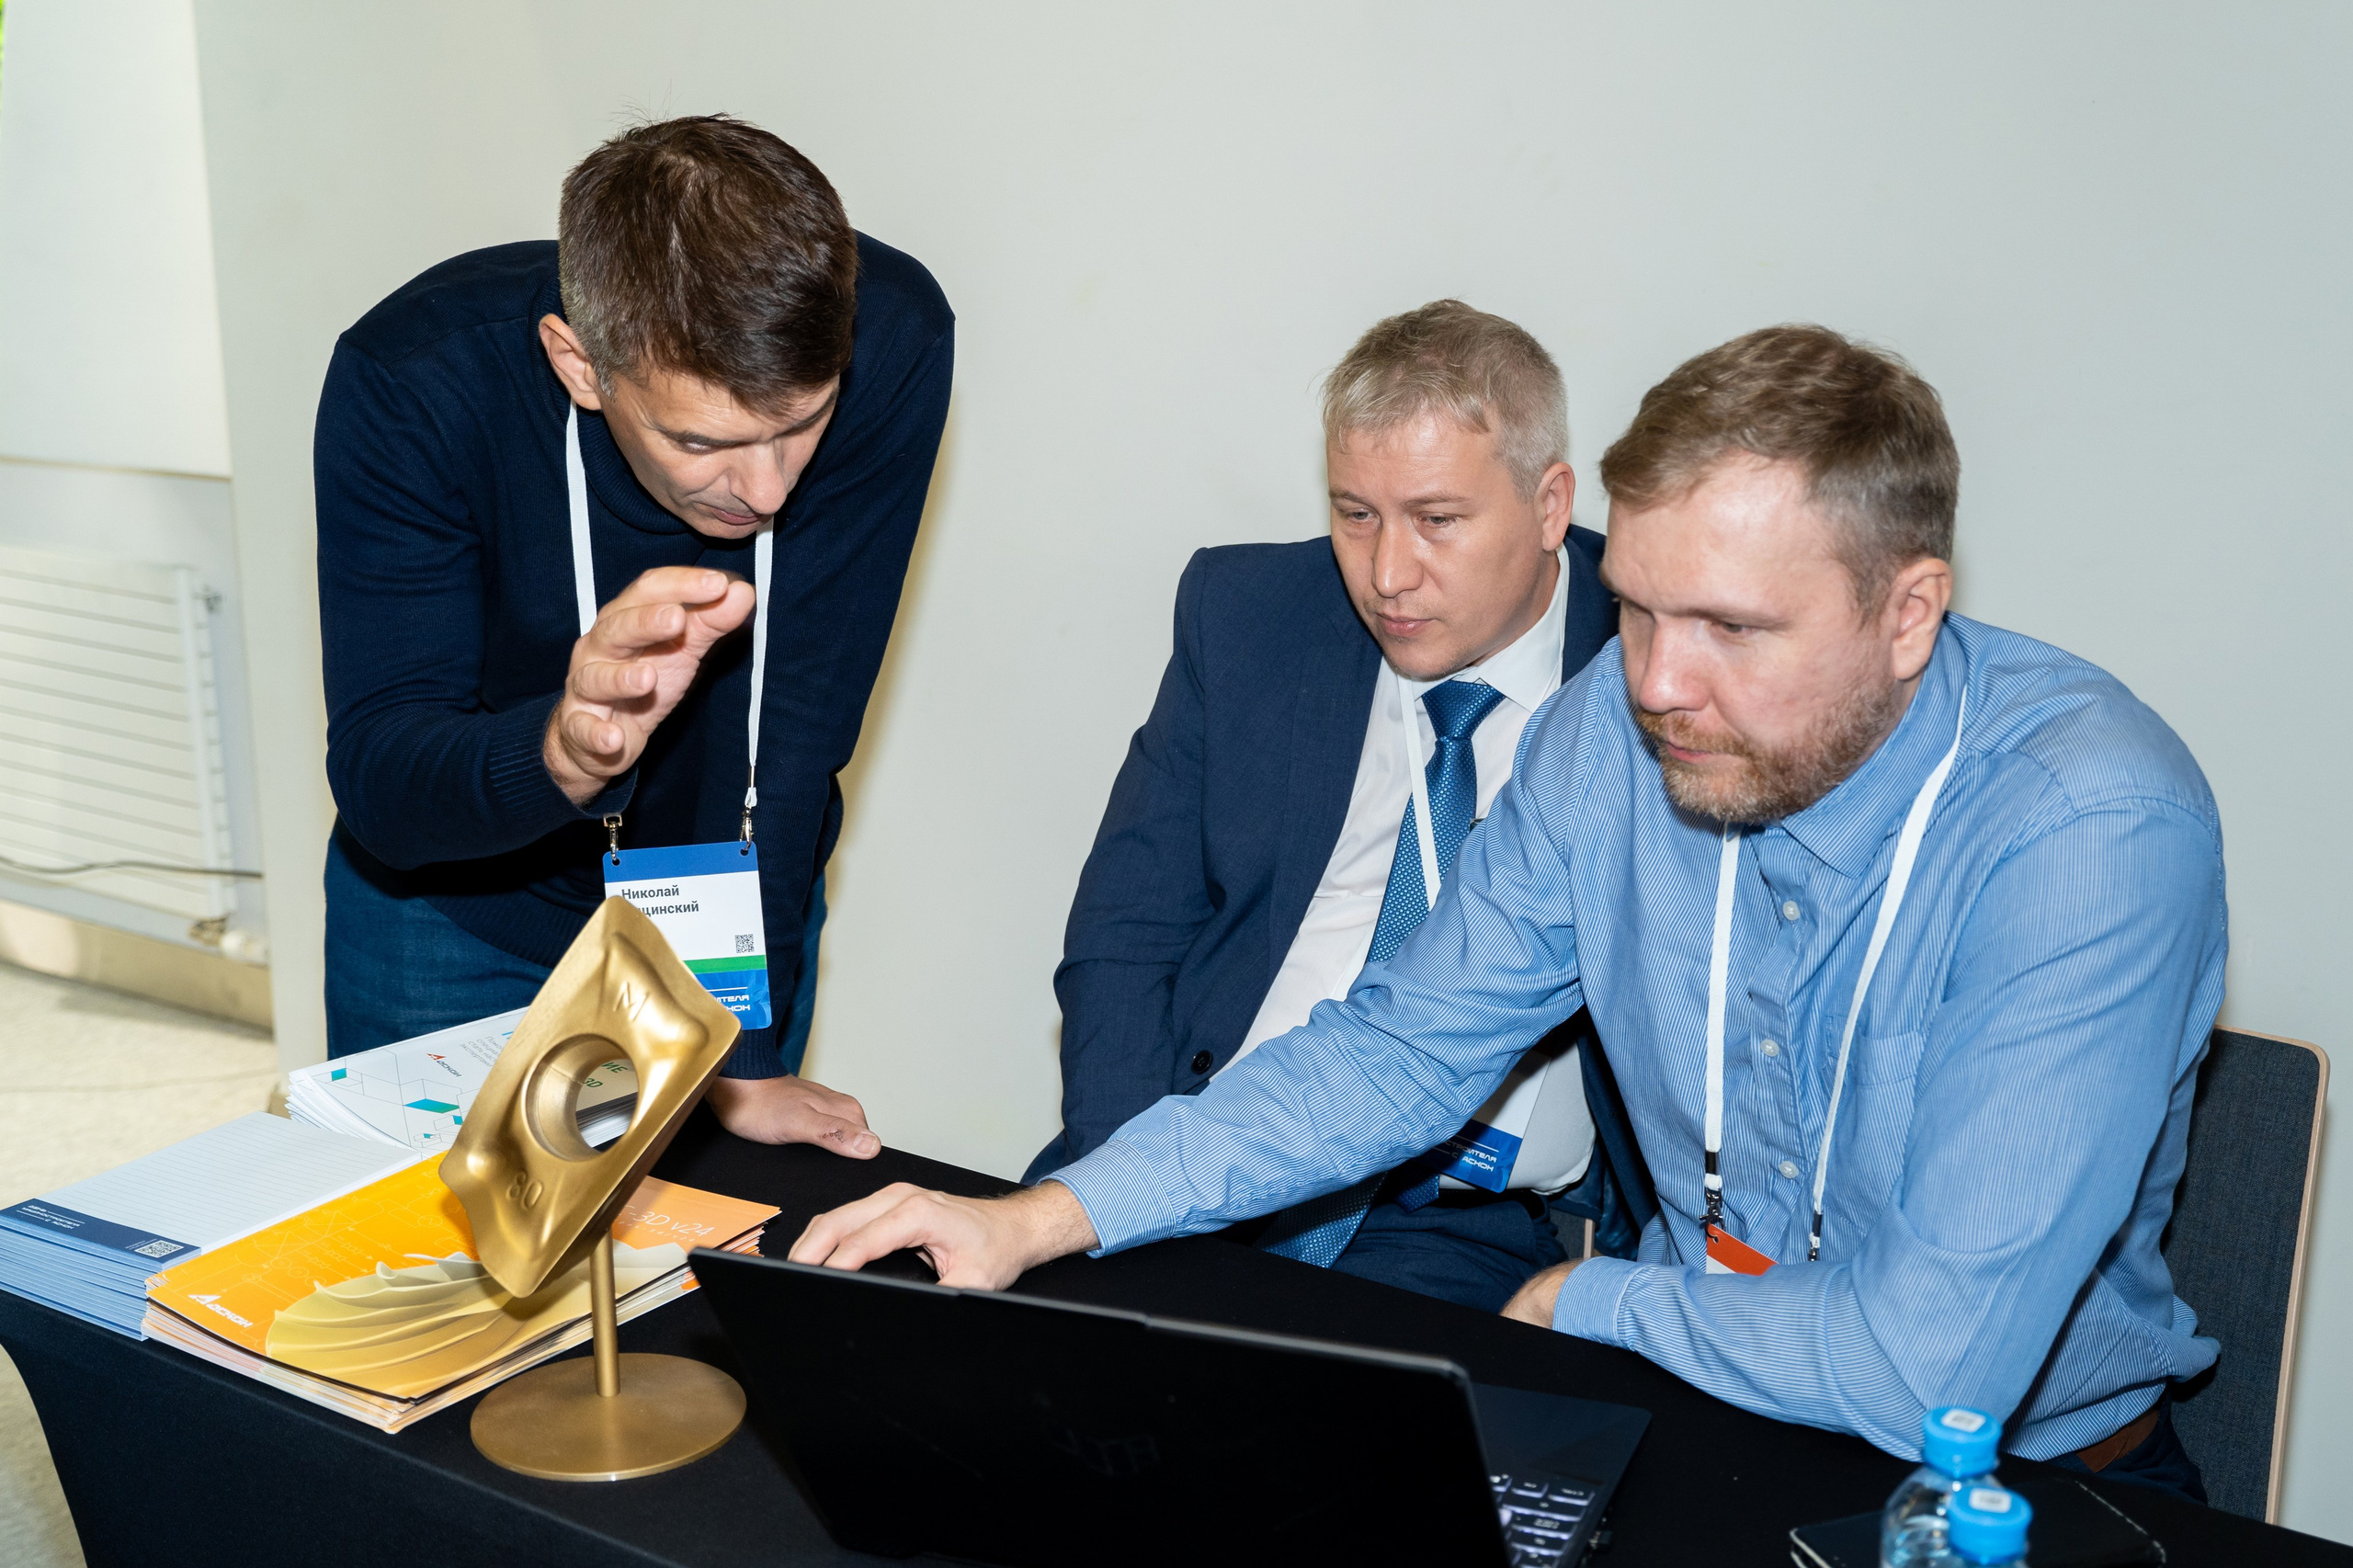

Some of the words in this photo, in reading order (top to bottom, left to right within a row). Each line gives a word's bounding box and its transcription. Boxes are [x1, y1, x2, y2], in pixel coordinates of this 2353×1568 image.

[621, 884, 679, 899] Николай
[601, 1062, 629, 1074] ИЕ
[583, 1077, 604, 1088] 3D
